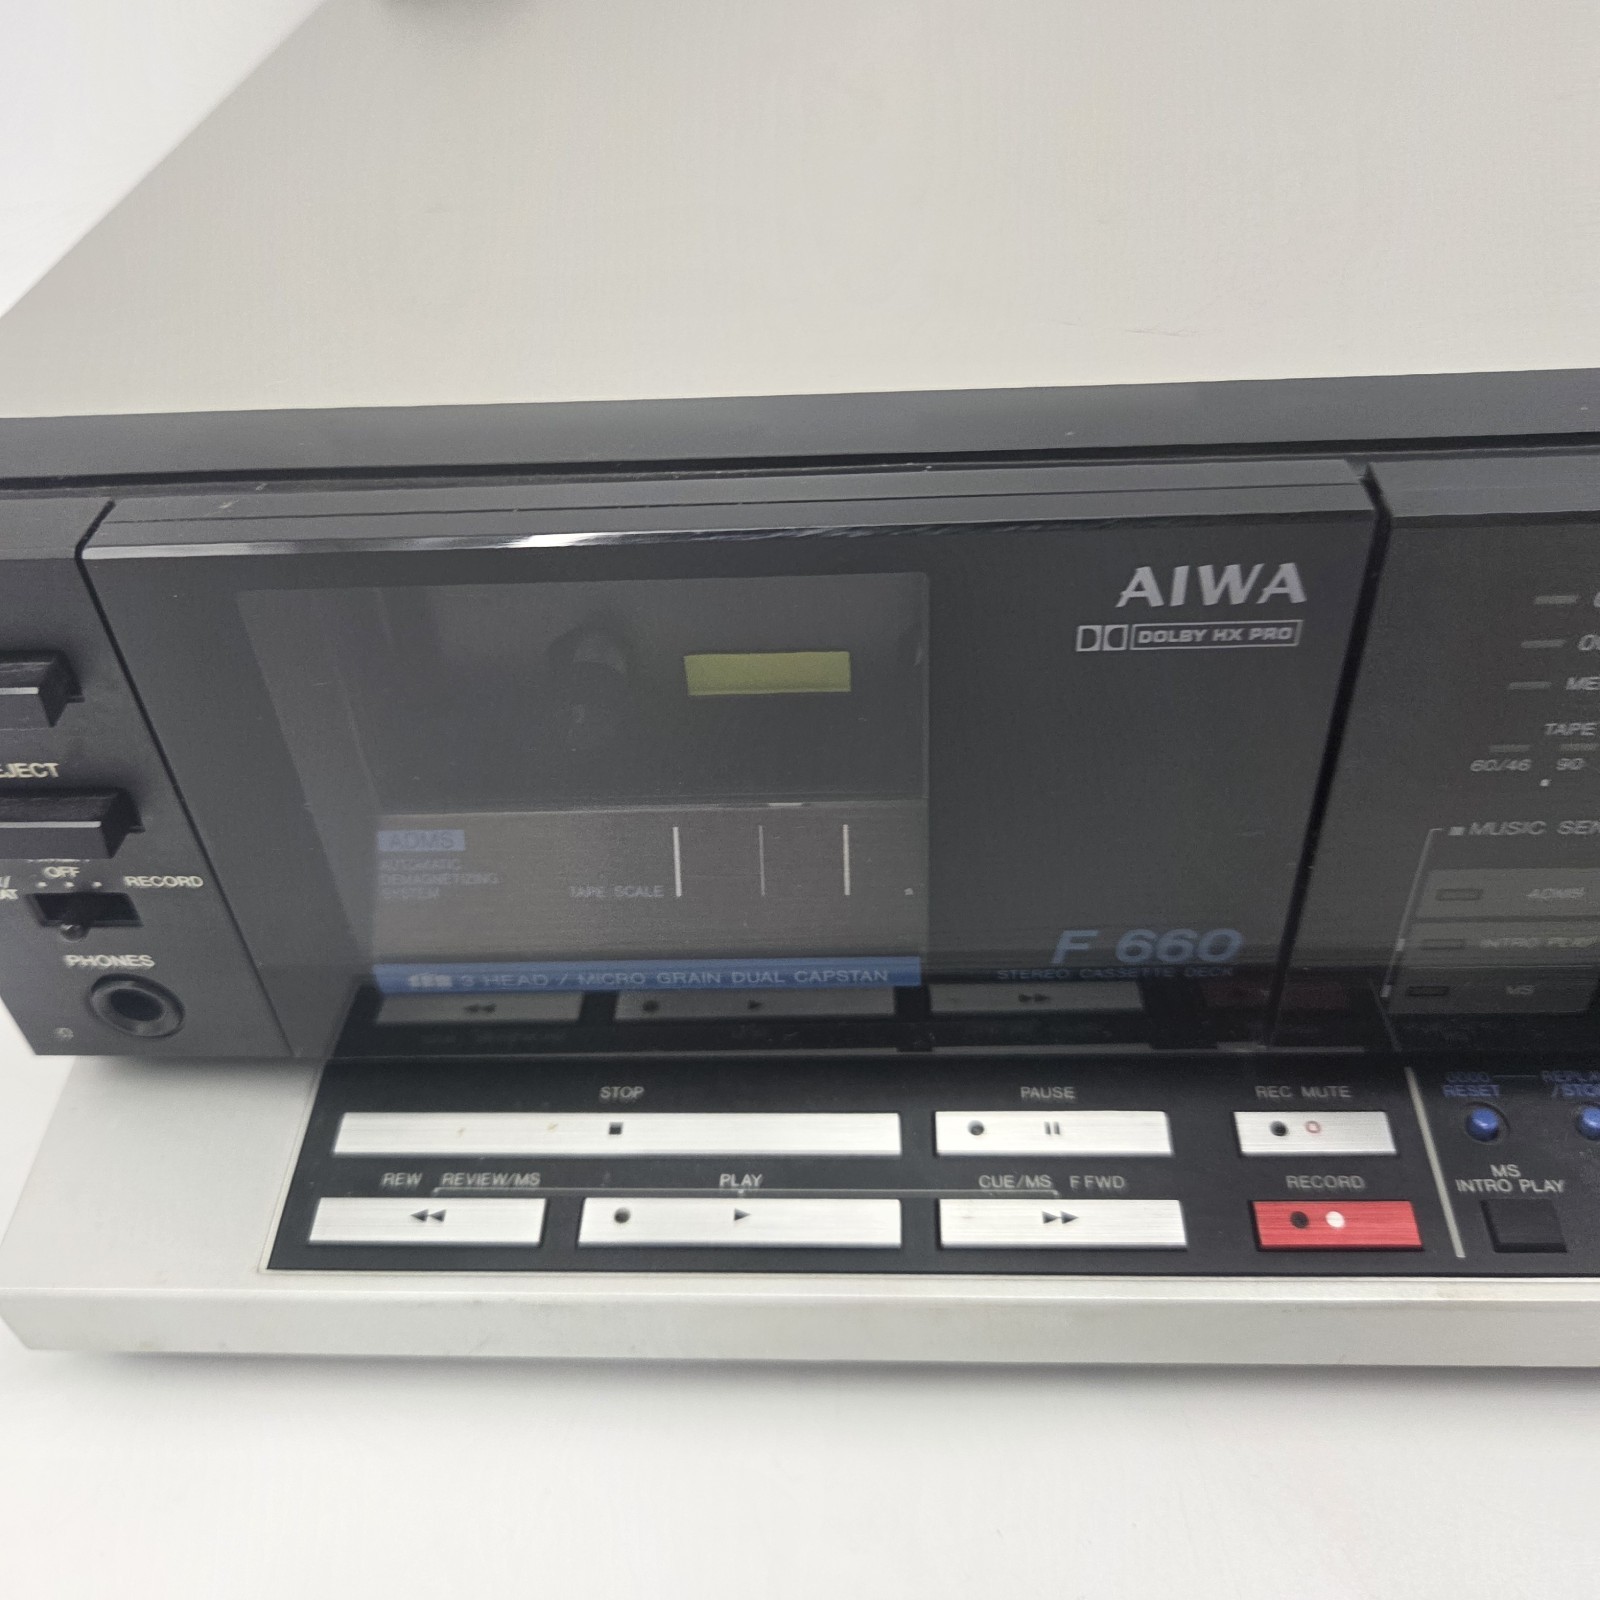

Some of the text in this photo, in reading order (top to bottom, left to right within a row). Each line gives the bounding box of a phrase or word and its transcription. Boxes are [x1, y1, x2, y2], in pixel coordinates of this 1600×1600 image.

[1115, 562, 1307, 608] AIWA
[1138, 626, 1294, 644] DOLBY HX PRO
[1544, 722, 1598, 736] TAPE
[1468, 820, 1547, 836] MUSIC
[43, 866, 80, 878] OFF
[123, 875, 204, 888] RECORD
[569, 885, 665, 899] TAPE SCALE
[1051, 927, 1244, 965] F 660
[63, 954, 156, 968] PHONES
[460, 974, 475, 987] 3
[484, 973, 549, 986] HEAD
[577, 972, 646, 986] MICRO
[655, 971, 721, 985] GRAIN
[731, 970, 785, 984] DUAL
[793, 969, 889, 983] CAPSTAN
[997, 965, 1235, 981] STEREO CASSETTE DECK
[600, 1085, 645, 1100] STOP
[1020, 1086, 1076, 1100] PAUSE
[1255, 1085, 1352, 1098] REC MUTE
[1443, 1084, 1500, 1097] RESET
[1490, 1164, 1522, 1177] MS
[381, 1172, 541, 1187] REW REVIEW/MS
[719, 1173, 763, 1188] PLAY
[978, 1174, 1053, 1189] CUE/MS
[1285, 1175, 1366, 1190] RECORD
[1455, 1179, 1566, 1192] INTRO PLAY
